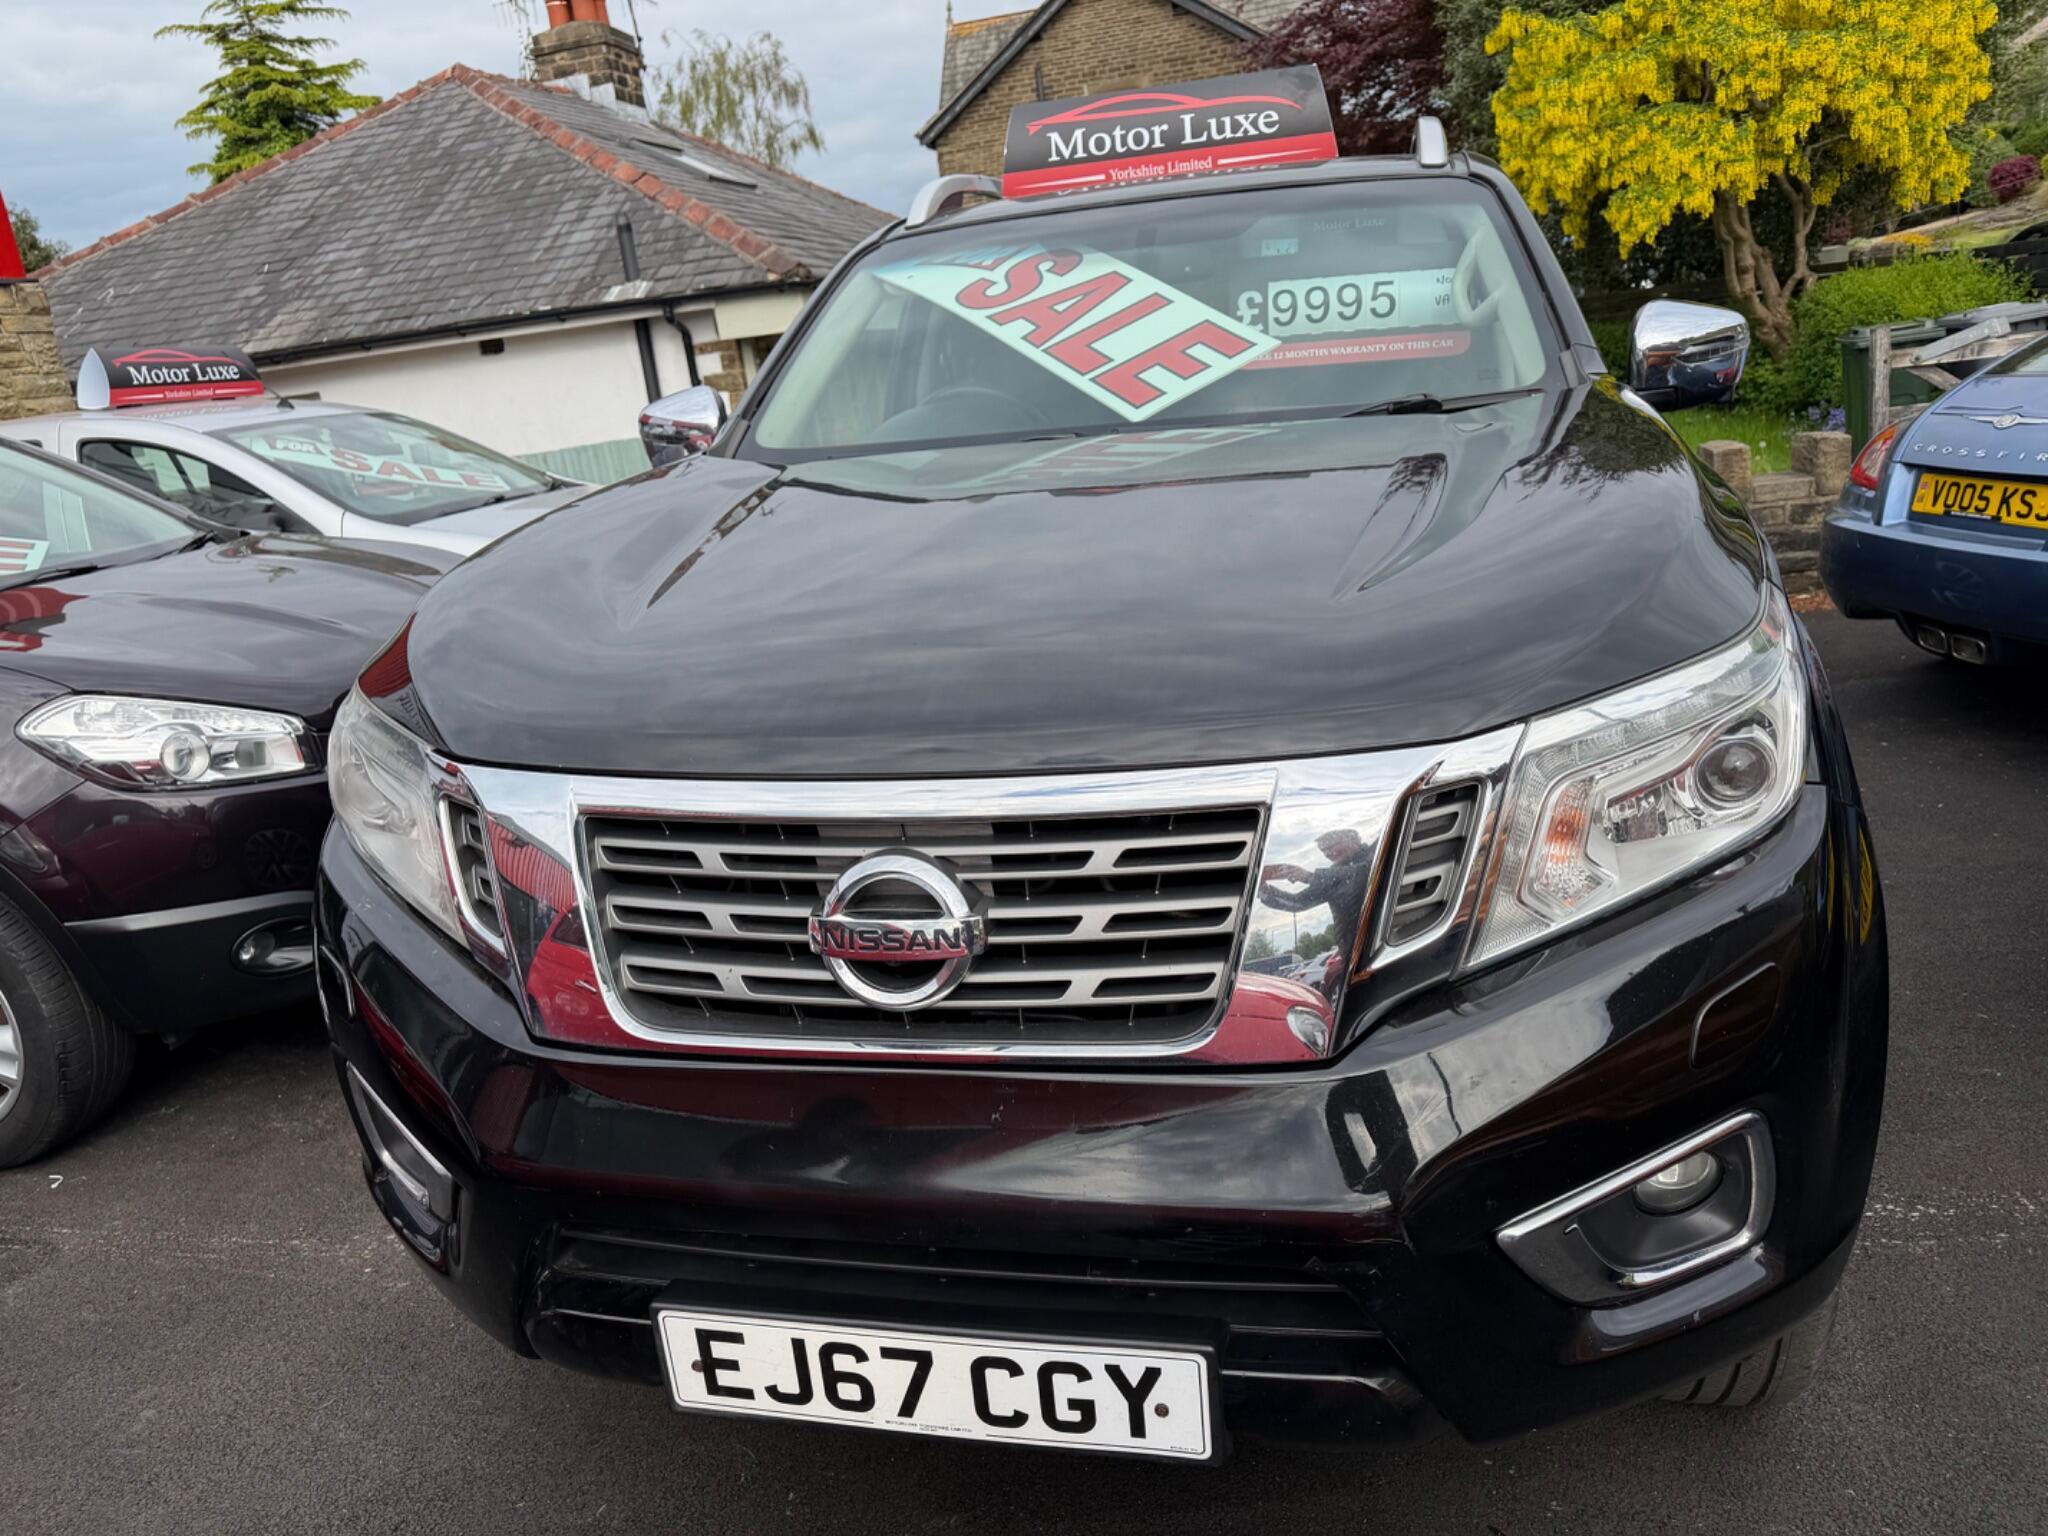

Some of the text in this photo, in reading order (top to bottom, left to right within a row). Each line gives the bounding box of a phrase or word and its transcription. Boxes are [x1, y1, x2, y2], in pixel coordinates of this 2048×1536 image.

[1048, 108, 1280, 162] Motor Luxe
[1108, 156, 1213, 181] Yorkshire Limited
[955, 248, 1258, 410] SALE
[1273, 351, 1284, 360] 12
[1285, 348, 1329, 360] MONTHS
[1330, 345, 1388, 356] WARRANTY
[1389, 342, 1405, 352] ON
[1406, 341, 1431, 350] THIS
[1432, 339, 1454, 348] CAR
[126, 362, 240, 385] Motor Luxe
[276, 438, 504, 489] FOR SALE
[822, 926, 962, 951] NISSAN
[694, 1327, 1163, 1439] EJ67 CGY
